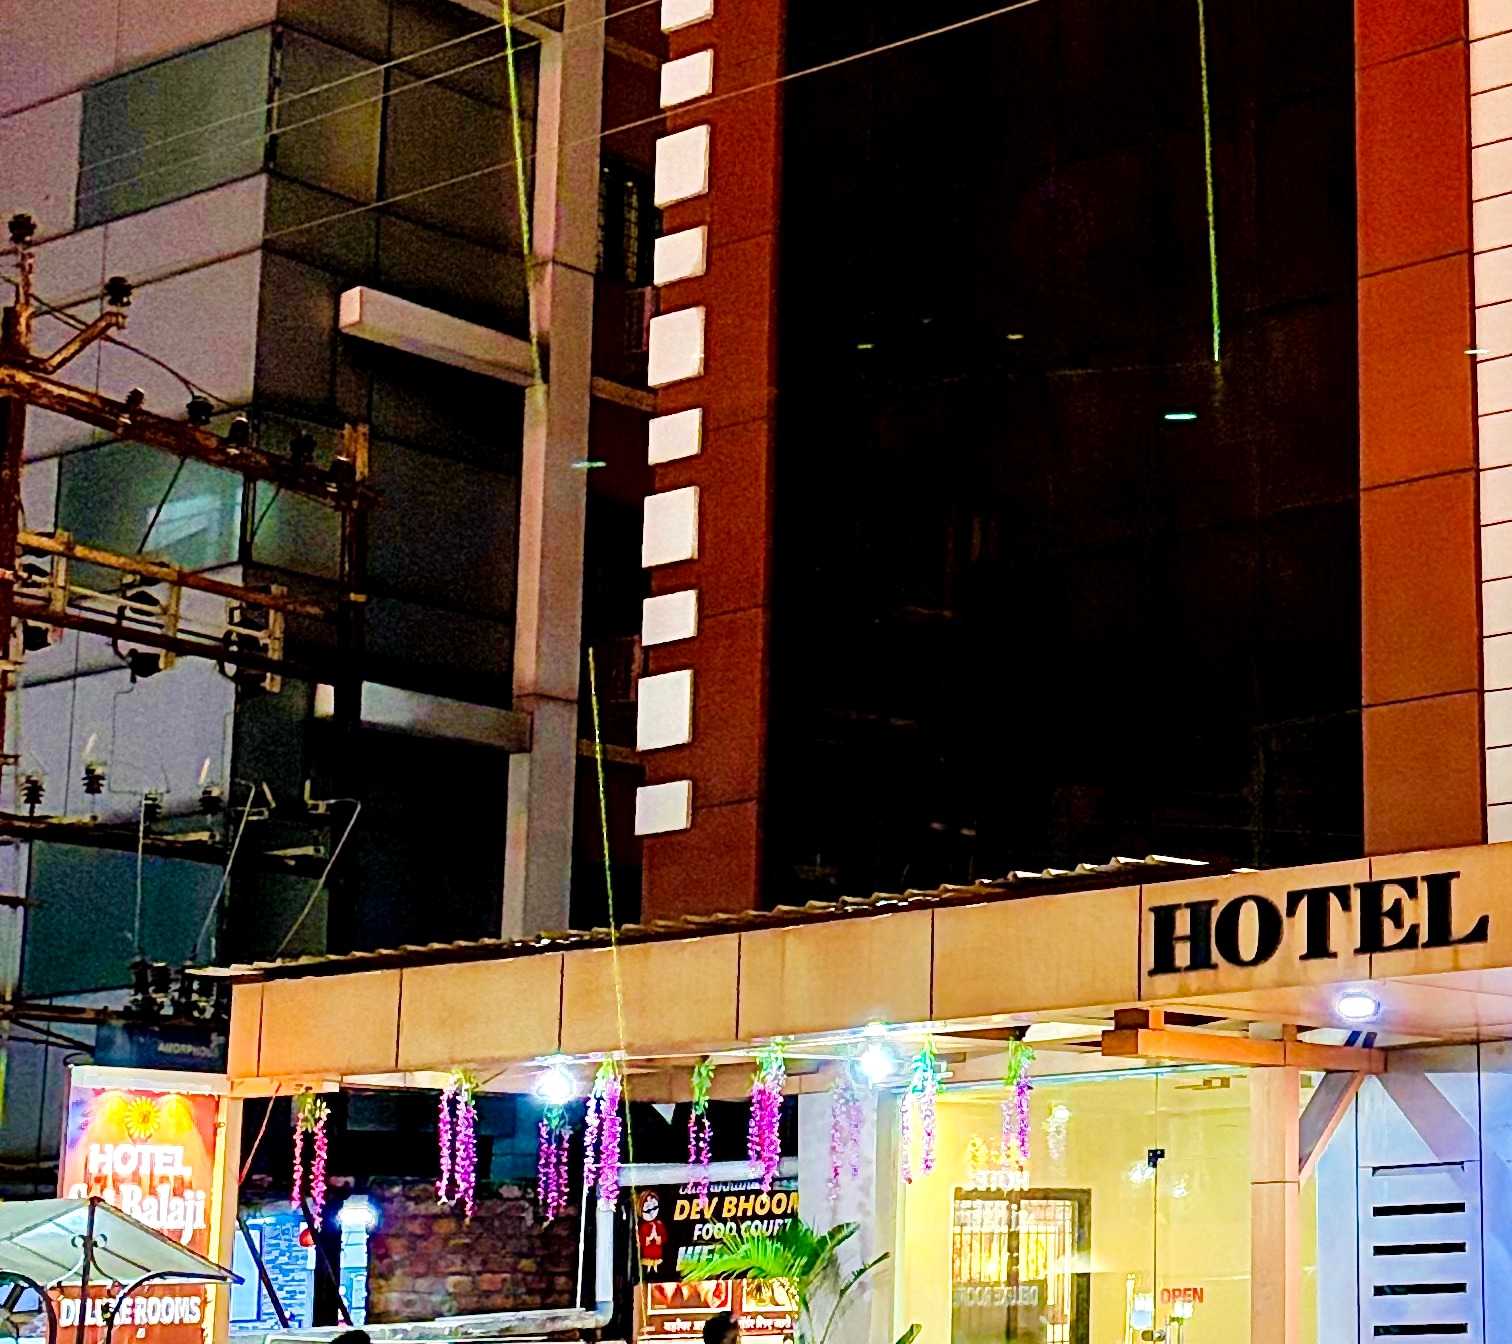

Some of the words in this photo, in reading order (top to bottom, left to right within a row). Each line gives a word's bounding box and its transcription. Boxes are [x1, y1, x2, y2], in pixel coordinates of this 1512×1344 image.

[1148, 871, 1490, 976] HOTEL
[88, 1143, 192, 1176] HOTEL
[673, 1196, 719, 1221] DEV
[693, 1221, 737, 1241] FOOD
[1160, 1288, 1204, 1304] OPEN
[134, 1296, 202, 1325] ROOMS
